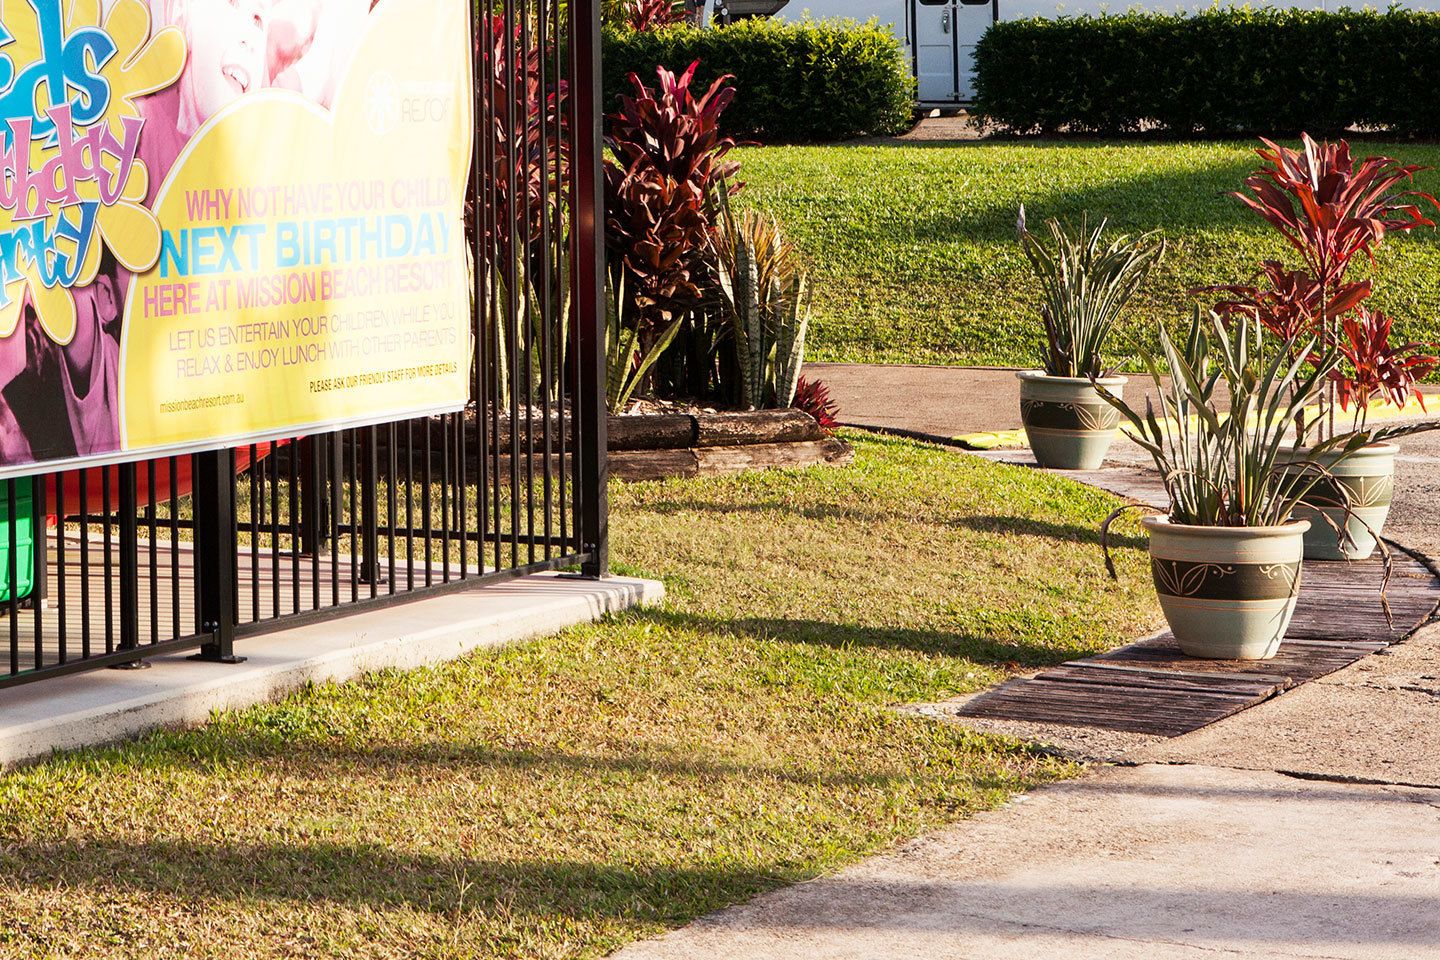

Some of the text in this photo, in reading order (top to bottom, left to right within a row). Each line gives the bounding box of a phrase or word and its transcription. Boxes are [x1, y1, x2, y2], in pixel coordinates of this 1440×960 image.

[185, 188, 234, 222] WHY
[237, 184, 282, 218] NOT
[284, 180, 334, 217] HAVE
[335, 179, 386, 213] YOUR
[159, 211, 451, 279] NEXT BIRTHDAY
[143, 259, 454, 319] HERE AT MISSION BEACH RESORT
[169, 301, 456, 351] LET US ENTERTAIN YOUR CHILDREN WHILE YOU
[176, 326, 457, 378] RELAX & ENJOY LUNCH WITH OTHER PARENTS
[309, 361, 458, 393] PLEASE ASK OUR FRIENDLY STAFF FOR MORE DETAILS
